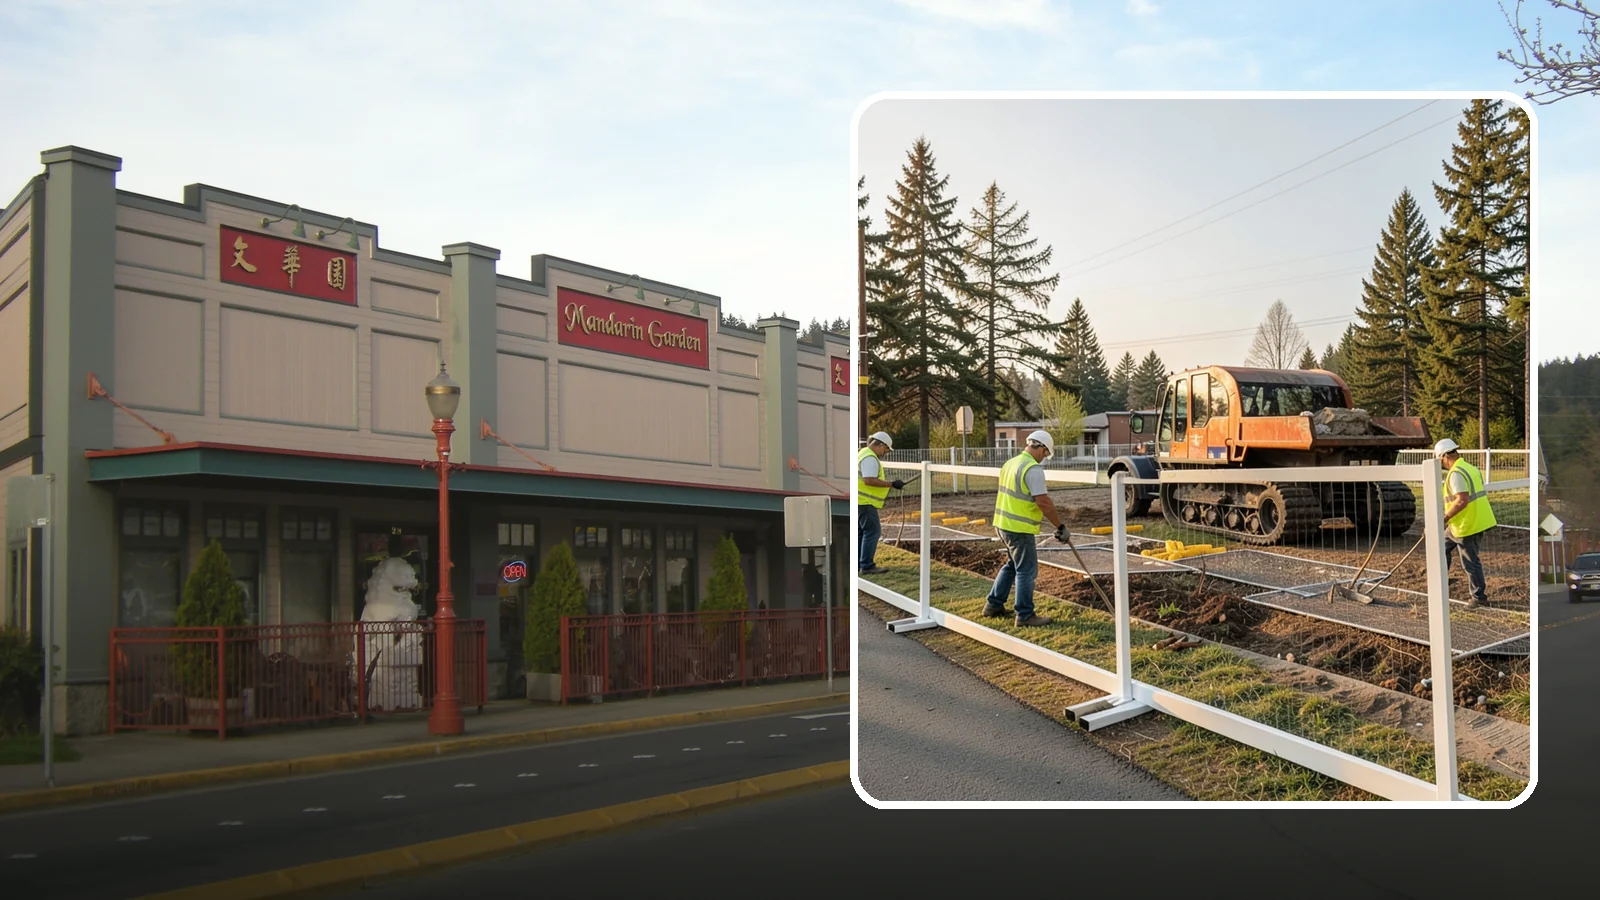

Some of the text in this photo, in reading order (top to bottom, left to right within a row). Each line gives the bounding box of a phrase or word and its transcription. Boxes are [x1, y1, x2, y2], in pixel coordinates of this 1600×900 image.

[230, 235, 346, 290] 文華園
[564, 302, 701, 352] Mandarin Garden
[834, 363, 846, 386] 文
[503, 565, 526, 578] OPEN
